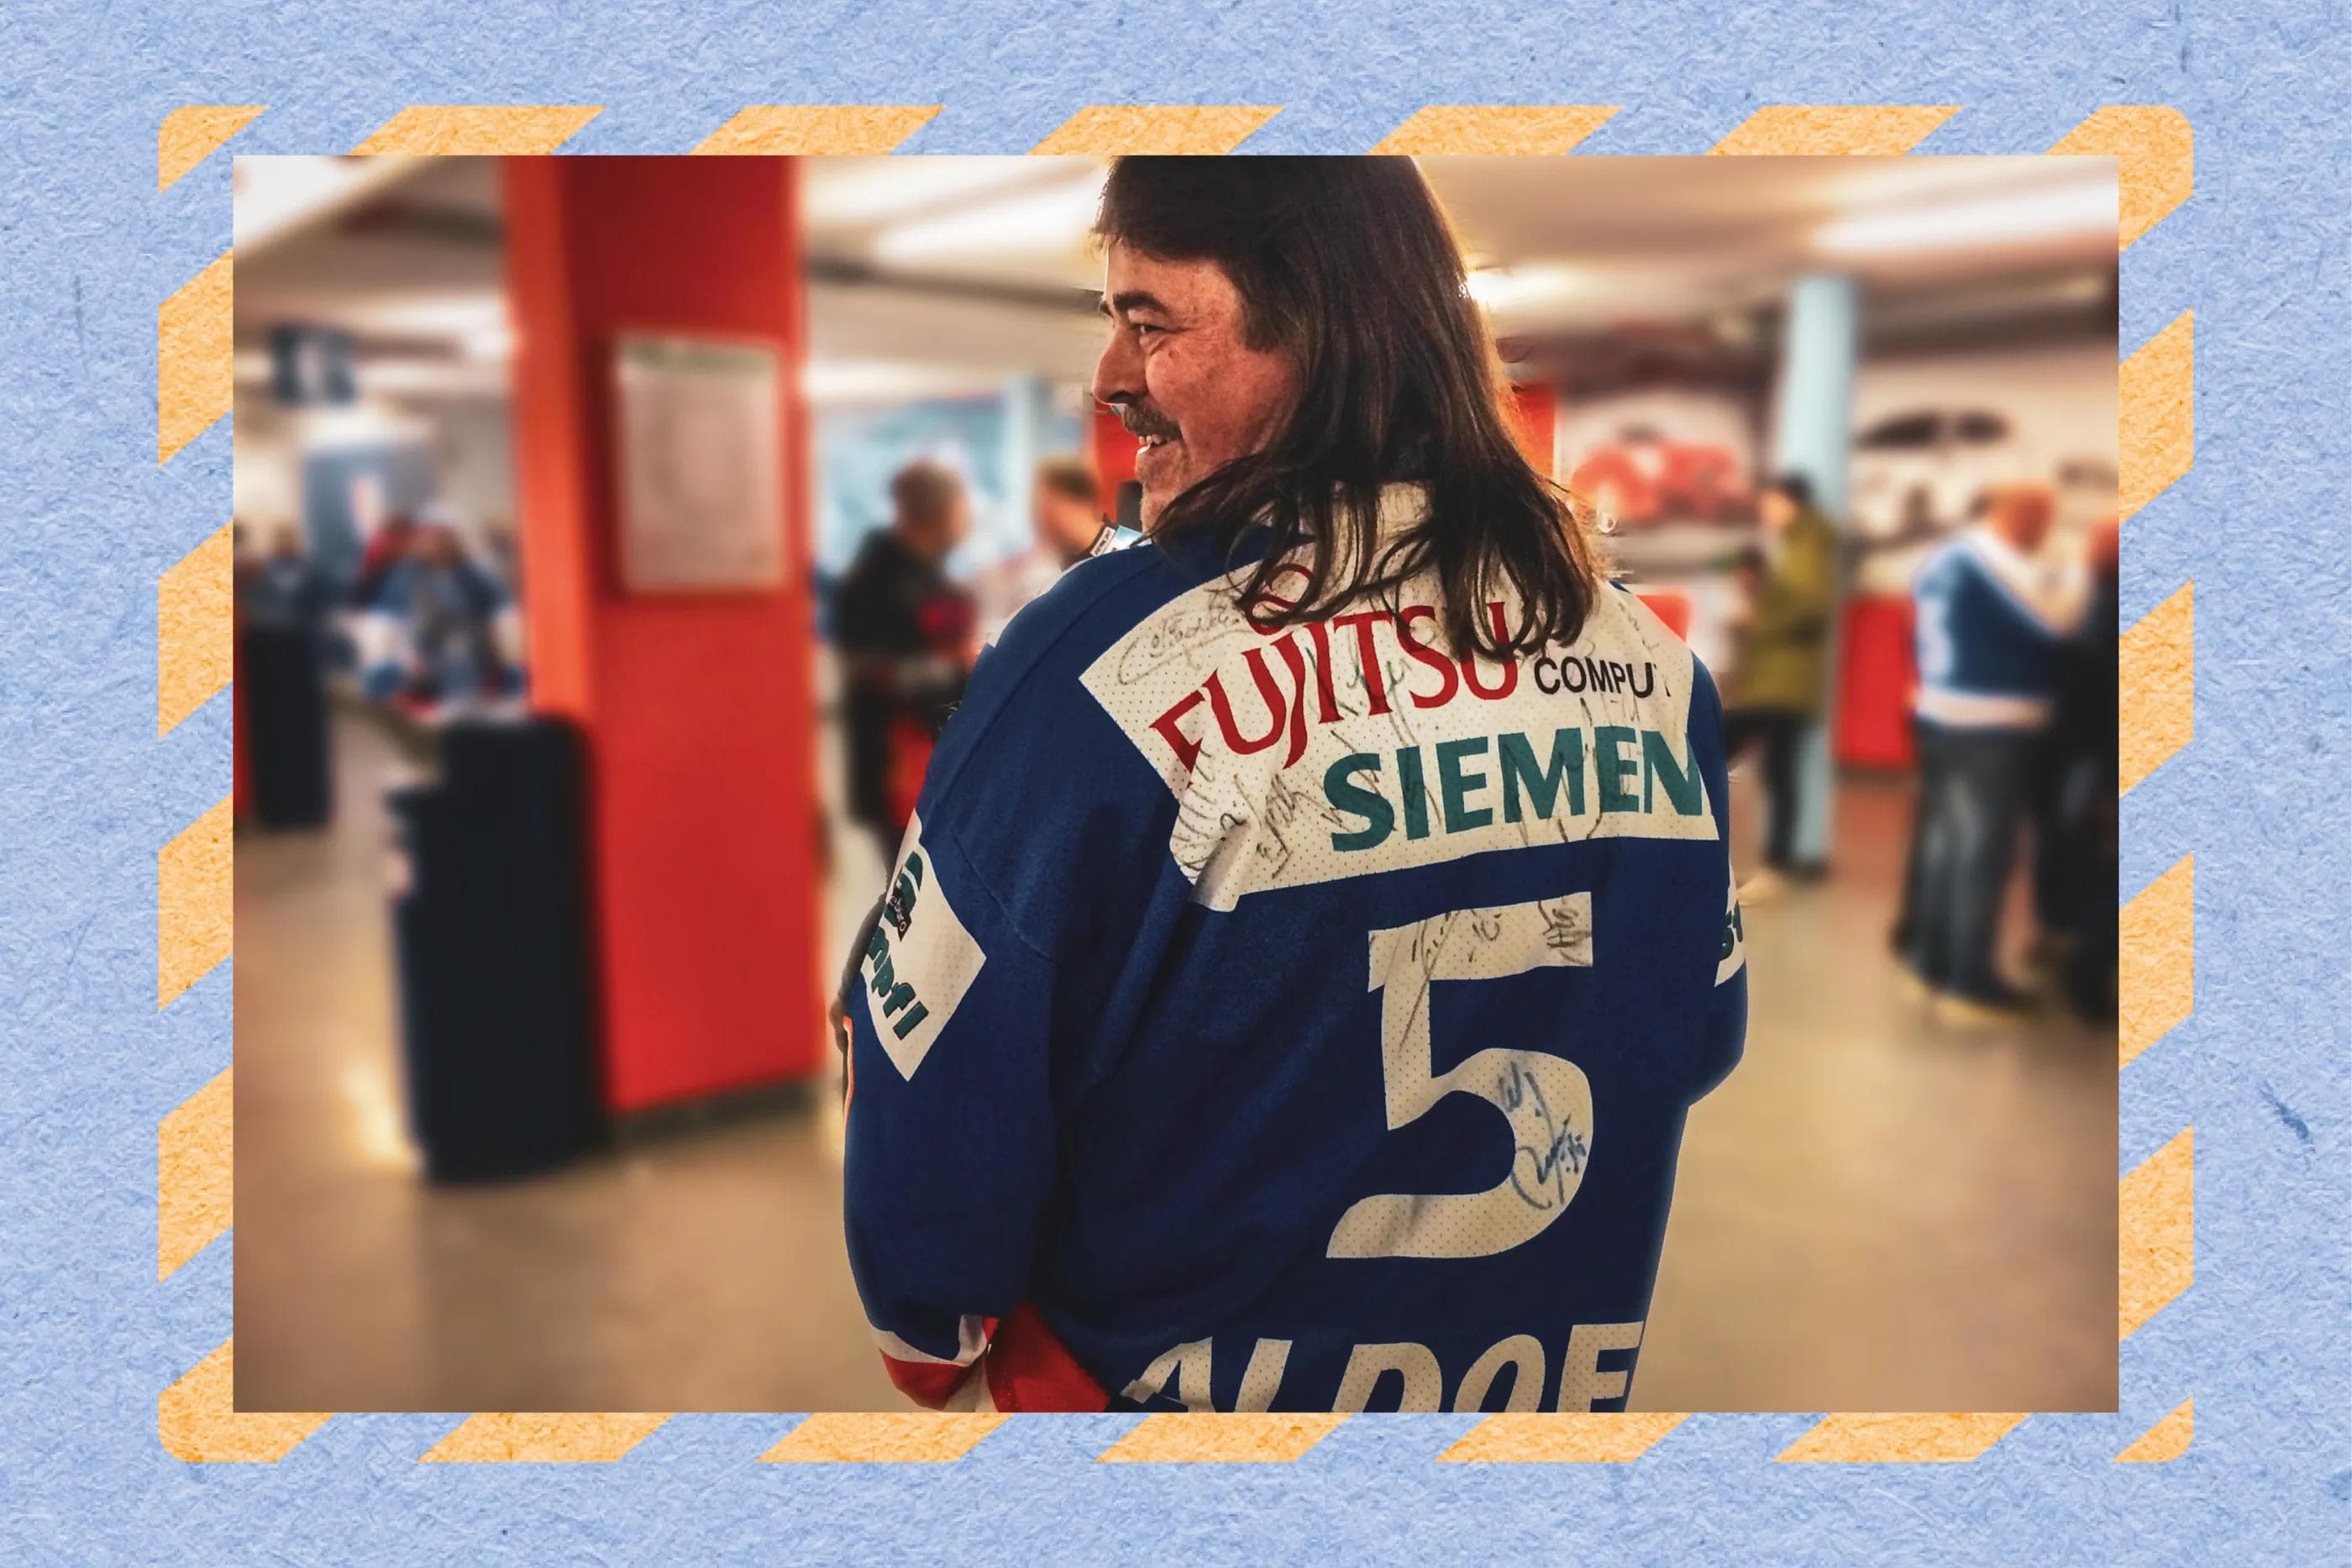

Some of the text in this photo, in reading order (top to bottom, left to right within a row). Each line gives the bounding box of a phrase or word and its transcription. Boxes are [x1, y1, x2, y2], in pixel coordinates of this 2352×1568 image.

[1148, 600, 1519, 774] FUJITSU
[1534, 656, 1671, 698] COMPU
[1326, 891, 1593, 1259] 5
